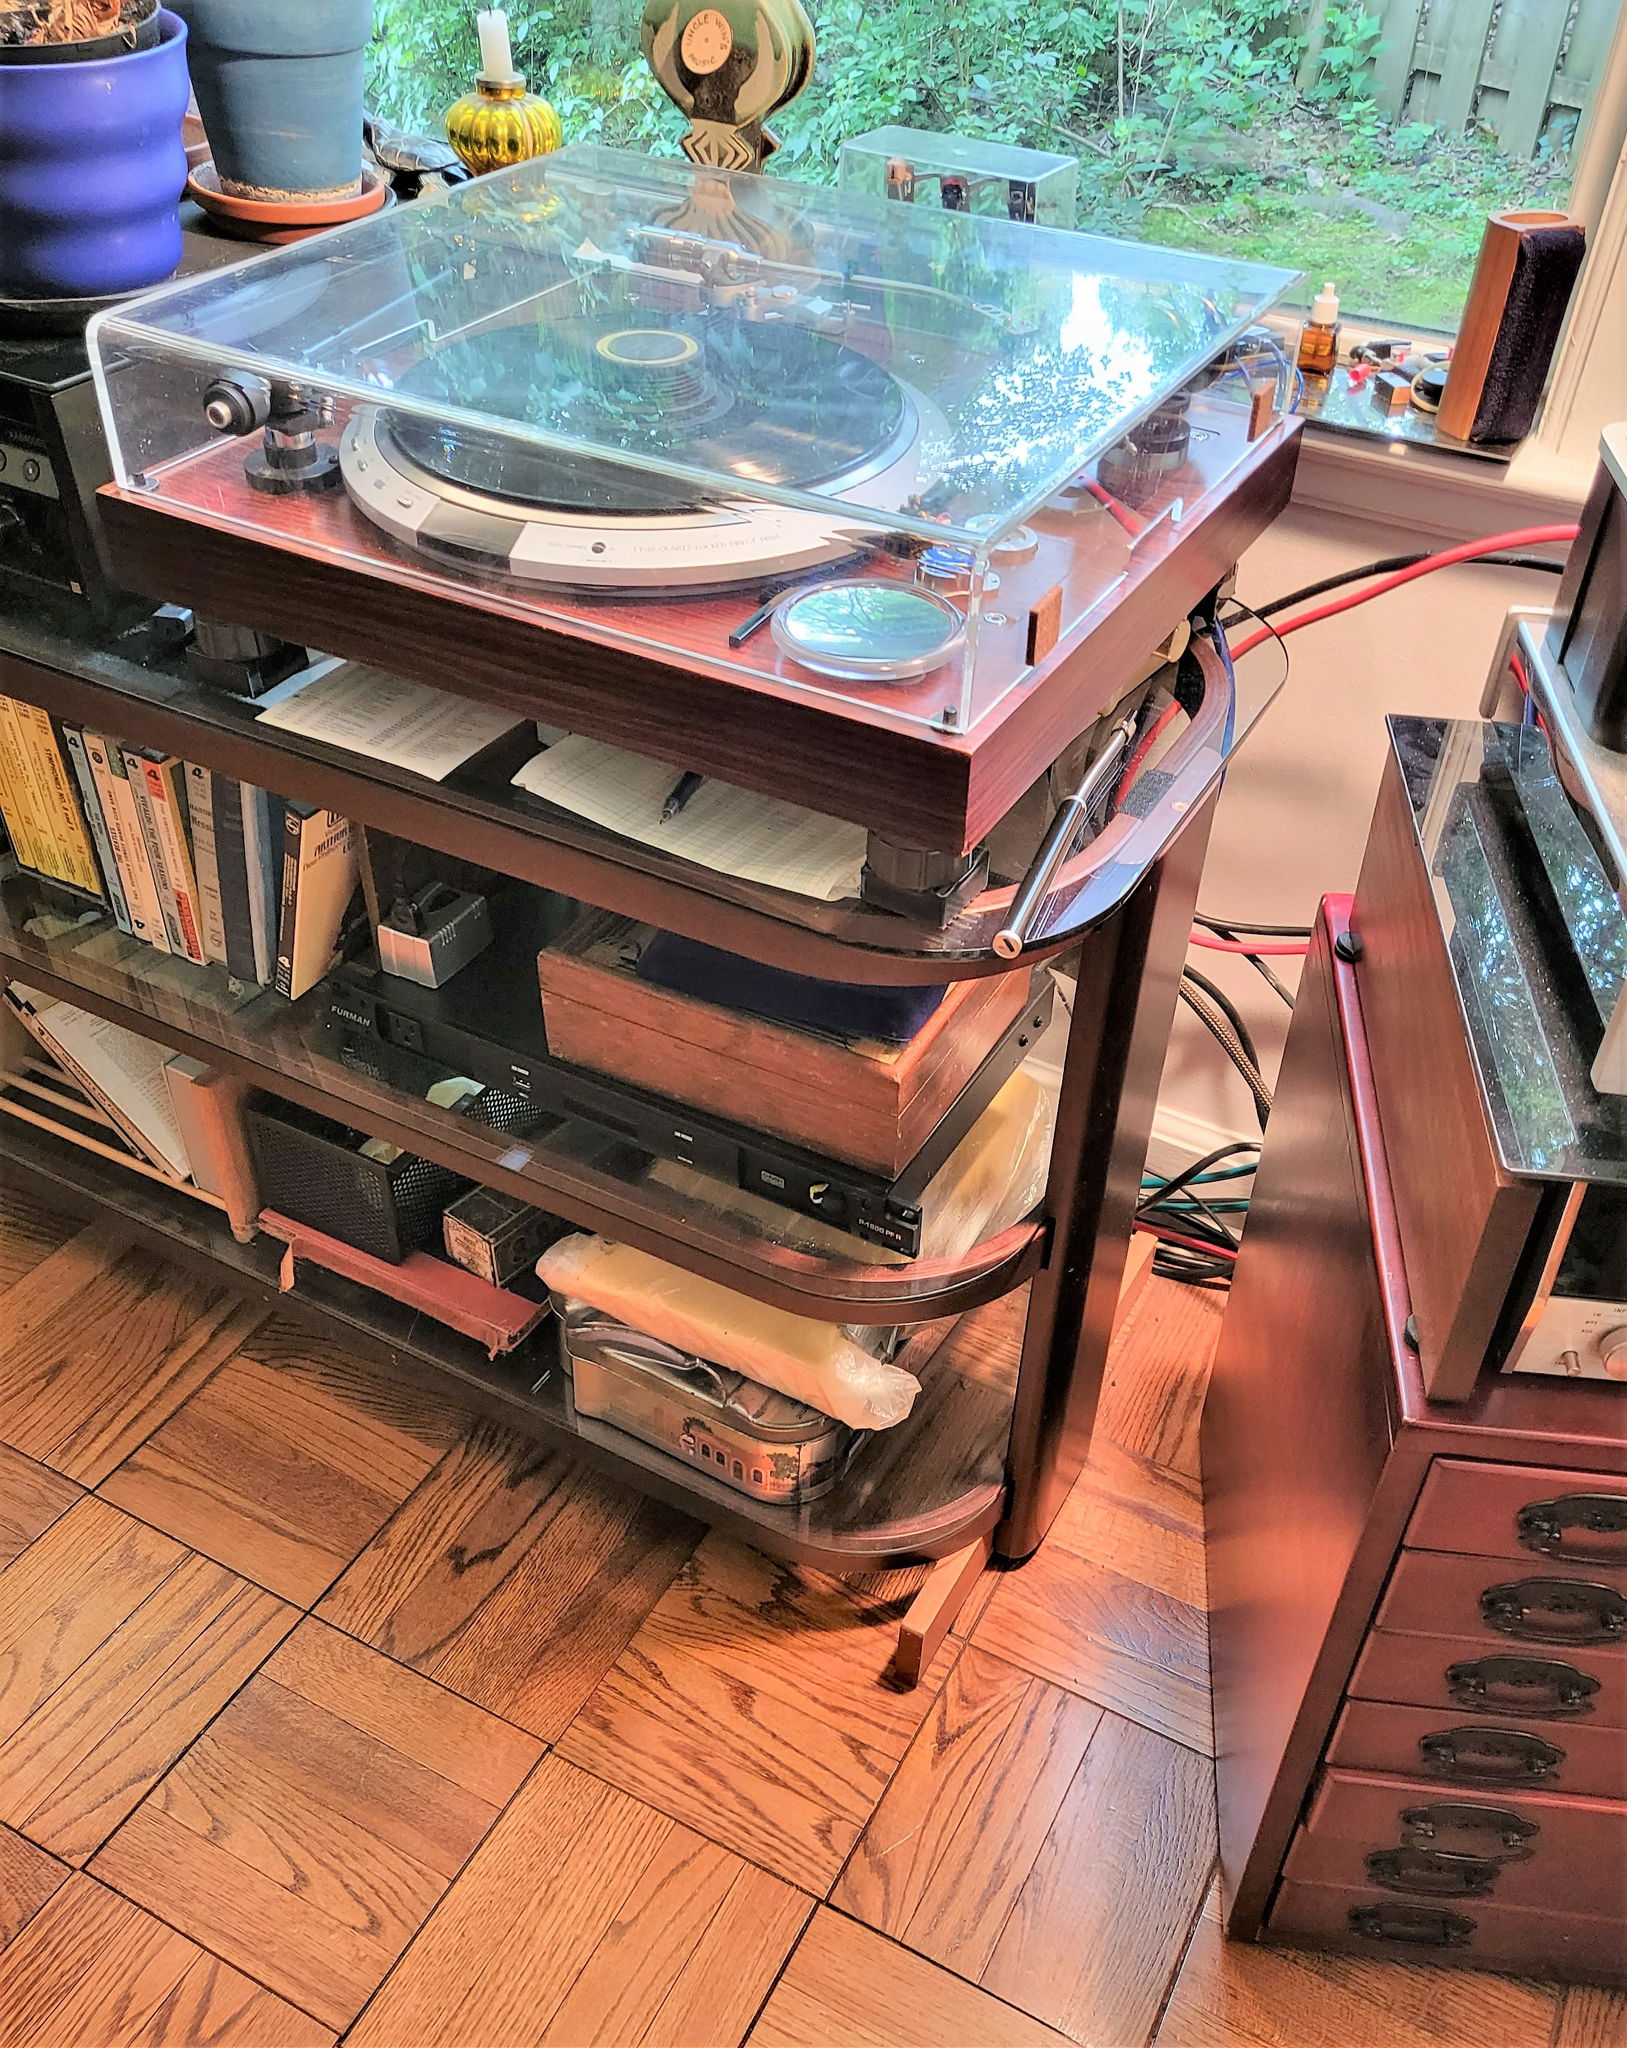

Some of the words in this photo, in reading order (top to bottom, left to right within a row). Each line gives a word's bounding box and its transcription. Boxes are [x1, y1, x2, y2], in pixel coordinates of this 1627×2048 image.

[685, 13, 710, 47] UNCLE
[715, 18, 729, 51] WIN'S
[687, 52, 716, 67] MUSIC
[658, 544, 692, 554] QUARTZ
[694, 542, 728, 552] LOCKED
[45, 748, 63, 790] SYMPHONIES
[108, 825, 121, 851] BEATLES
[150, 840, 162, 860] FOUR
[155, 860, 170, 891] SEASONS
[331, 1005, 371, 1027] FURMAN
[858, 1218, 885, 1234] P-1800
